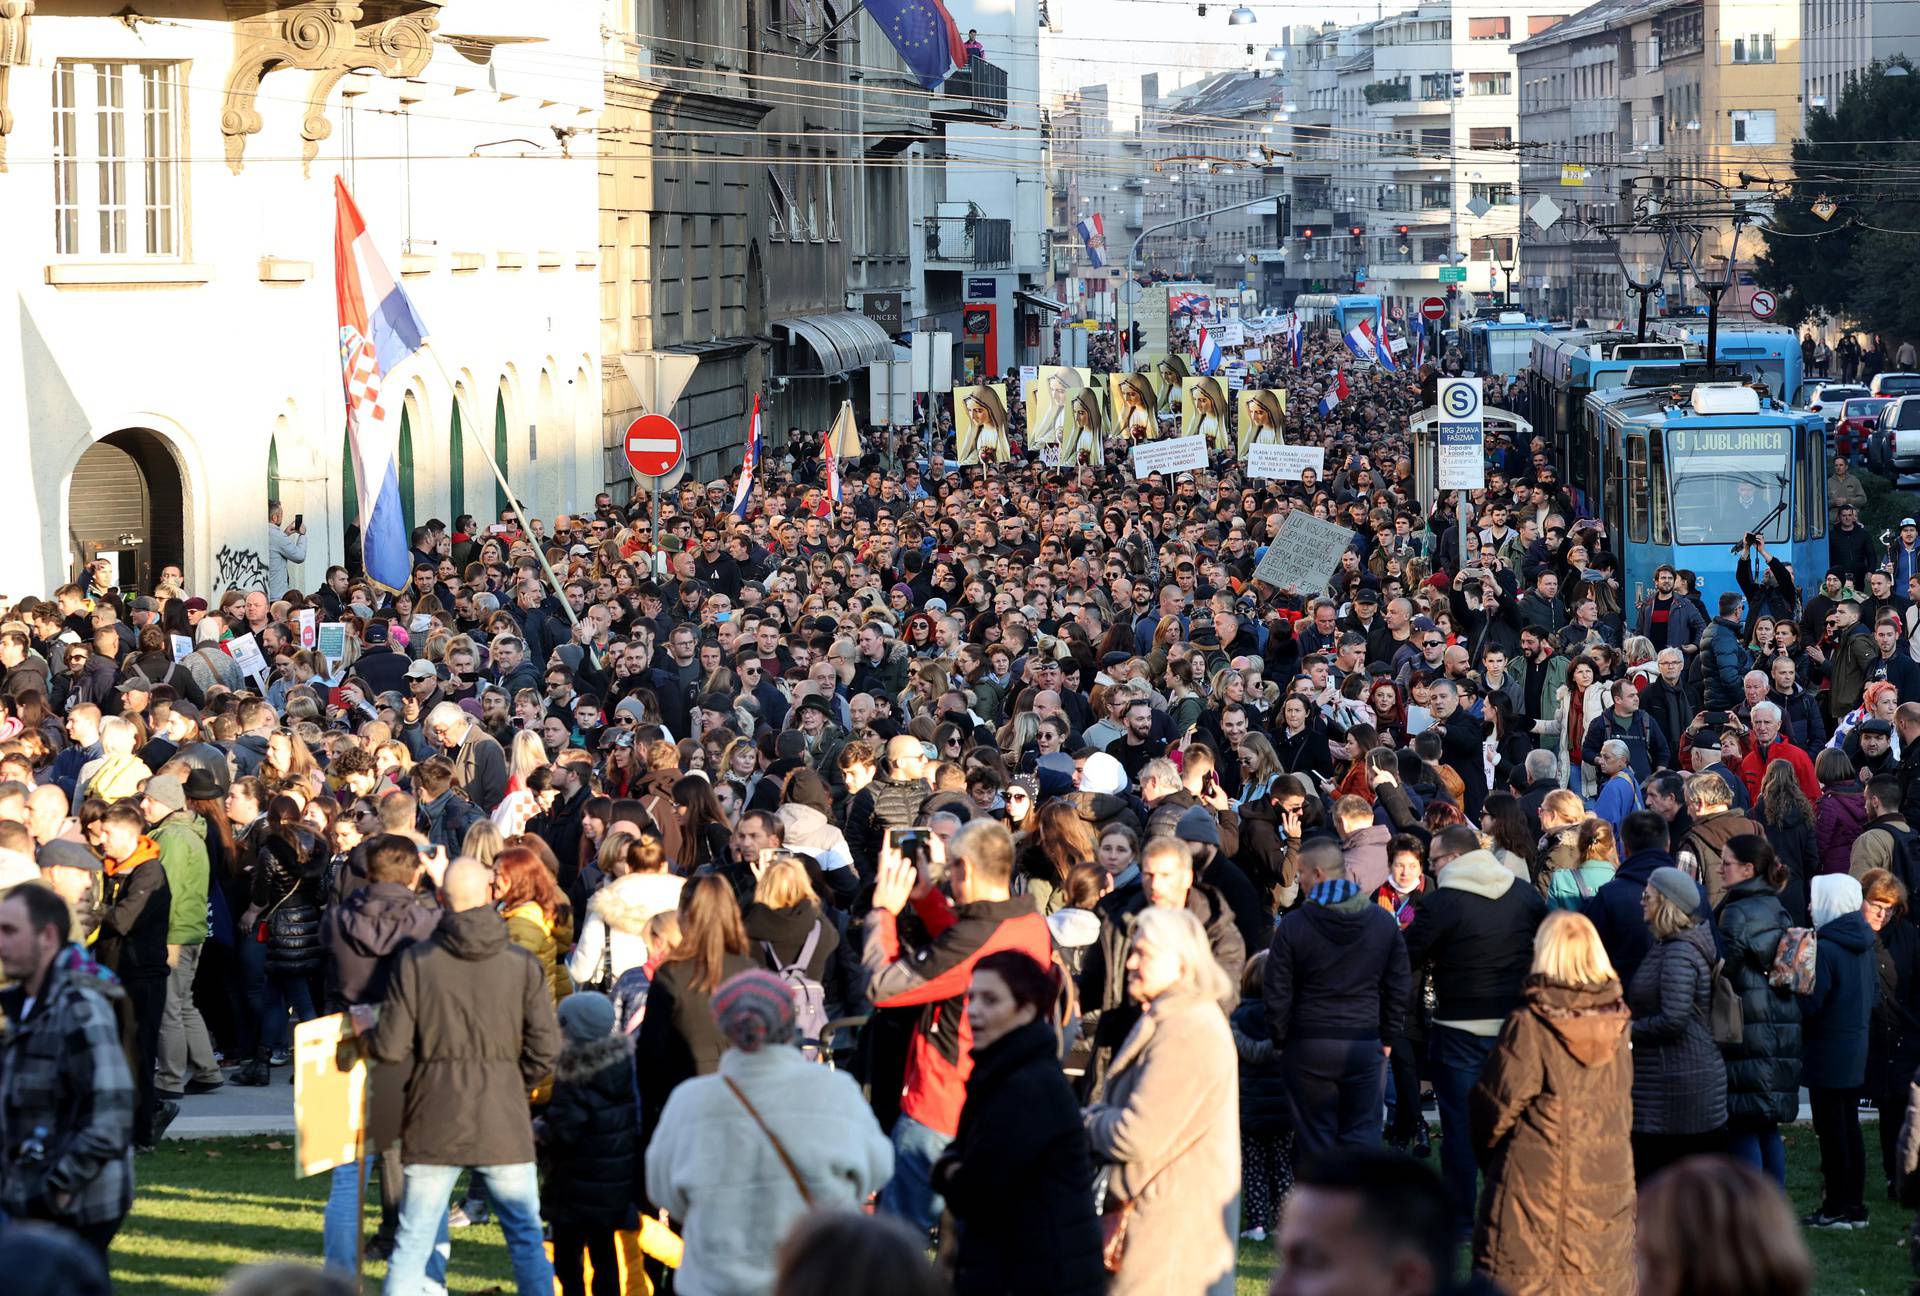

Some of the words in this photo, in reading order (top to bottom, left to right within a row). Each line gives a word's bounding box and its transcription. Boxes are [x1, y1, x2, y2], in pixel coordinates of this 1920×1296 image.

[1452, 390, 1469, 411] S
[1456, 425, 1480, 434] ŽRTAVA
[1446, 433, 1475, 441] FAŠIZMA
[1676, 431, 1686, 451] 9
[1694, 432, 1782, 450] LJUBLJANICA
[1147, 463, 1166, 471] PRAVDA
